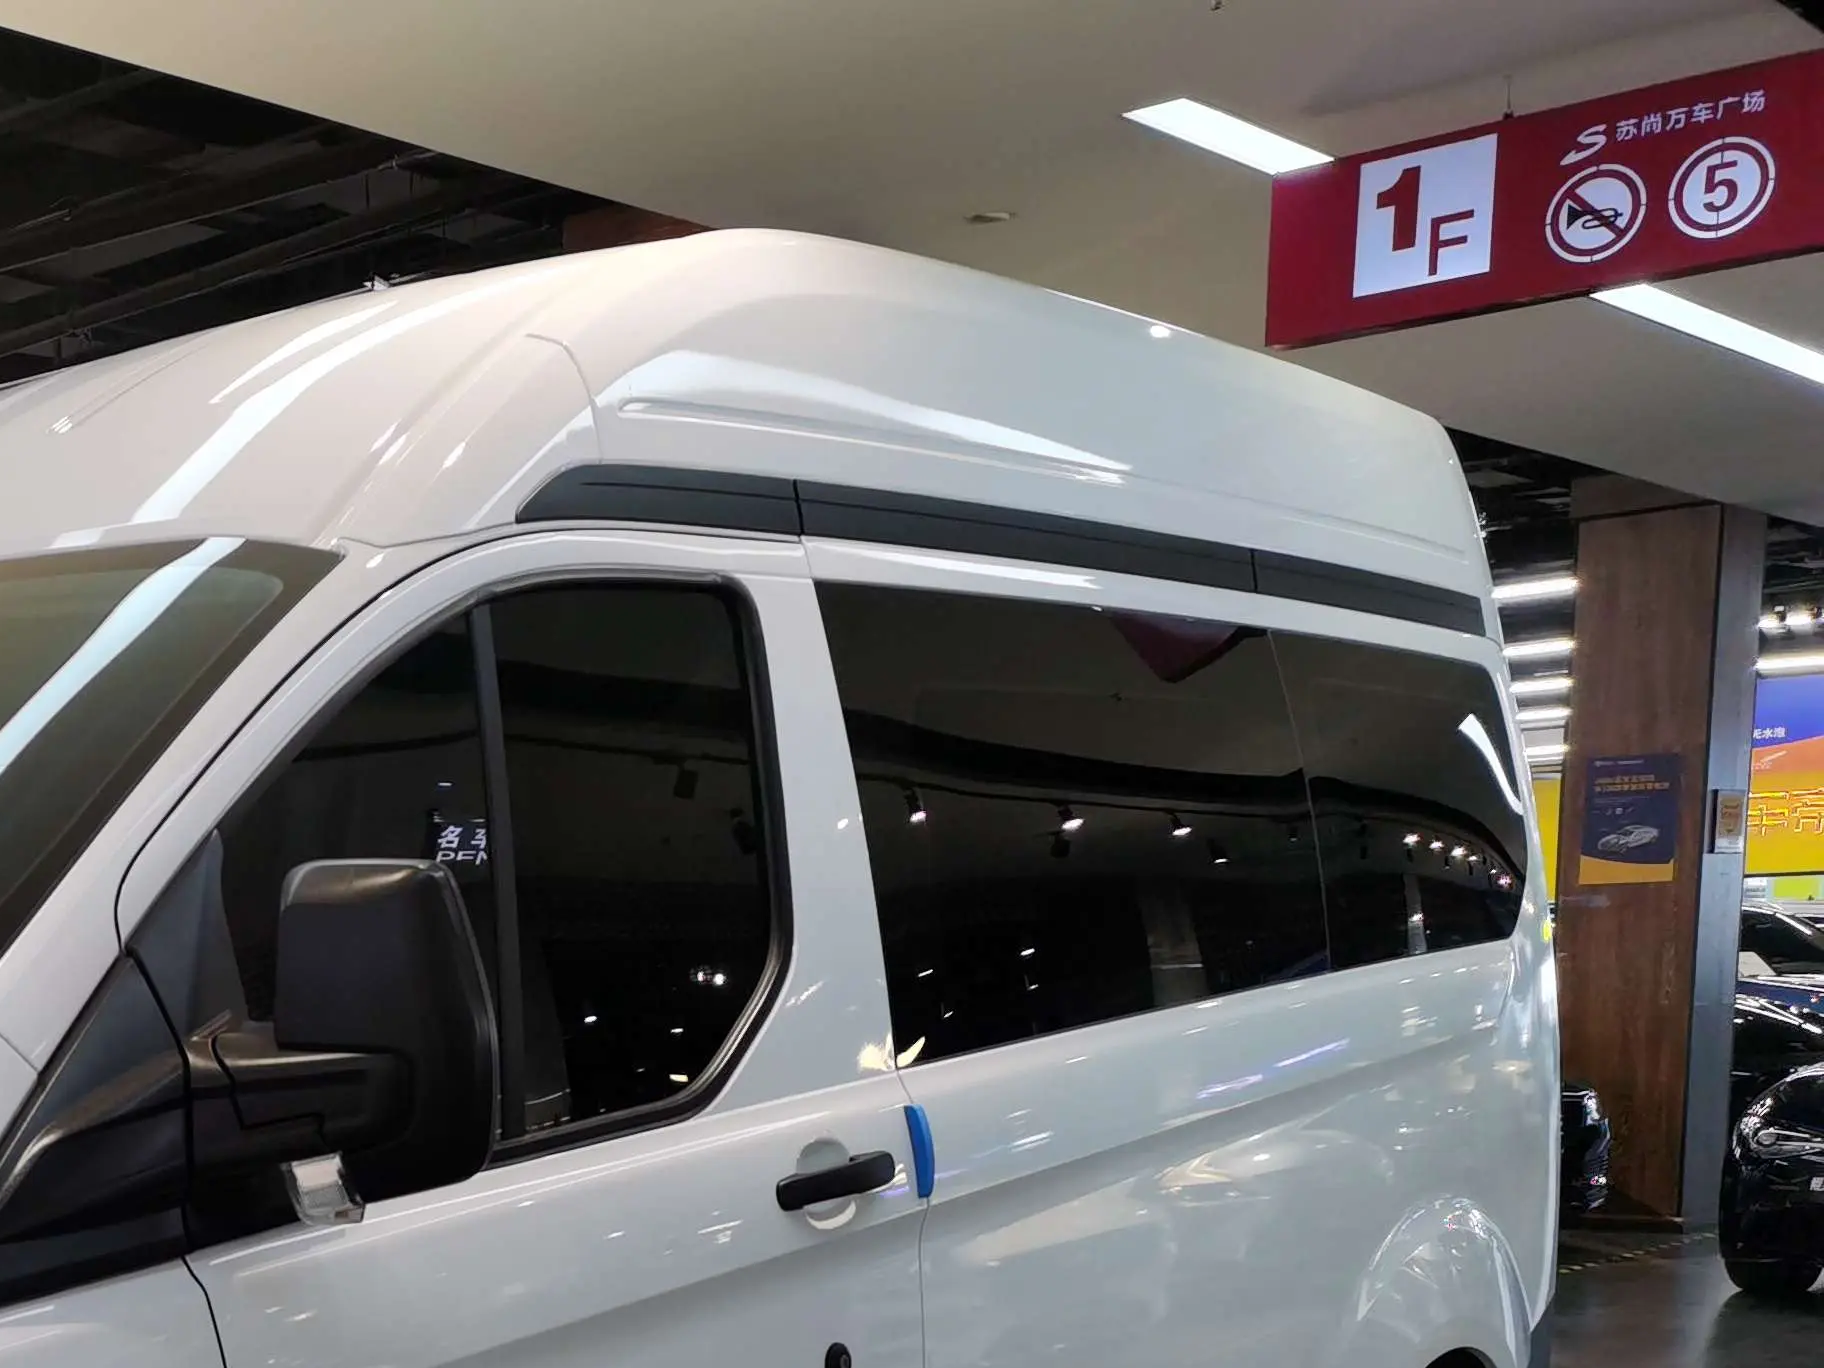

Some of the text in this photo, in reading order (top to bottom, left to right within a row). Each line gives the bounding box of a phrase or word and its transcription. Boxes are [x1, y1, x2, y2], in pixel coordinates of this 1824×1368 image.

[1615, 89, 1766, 142] 苏尚万车广场
[1702, 159, 1738, 213] 5
